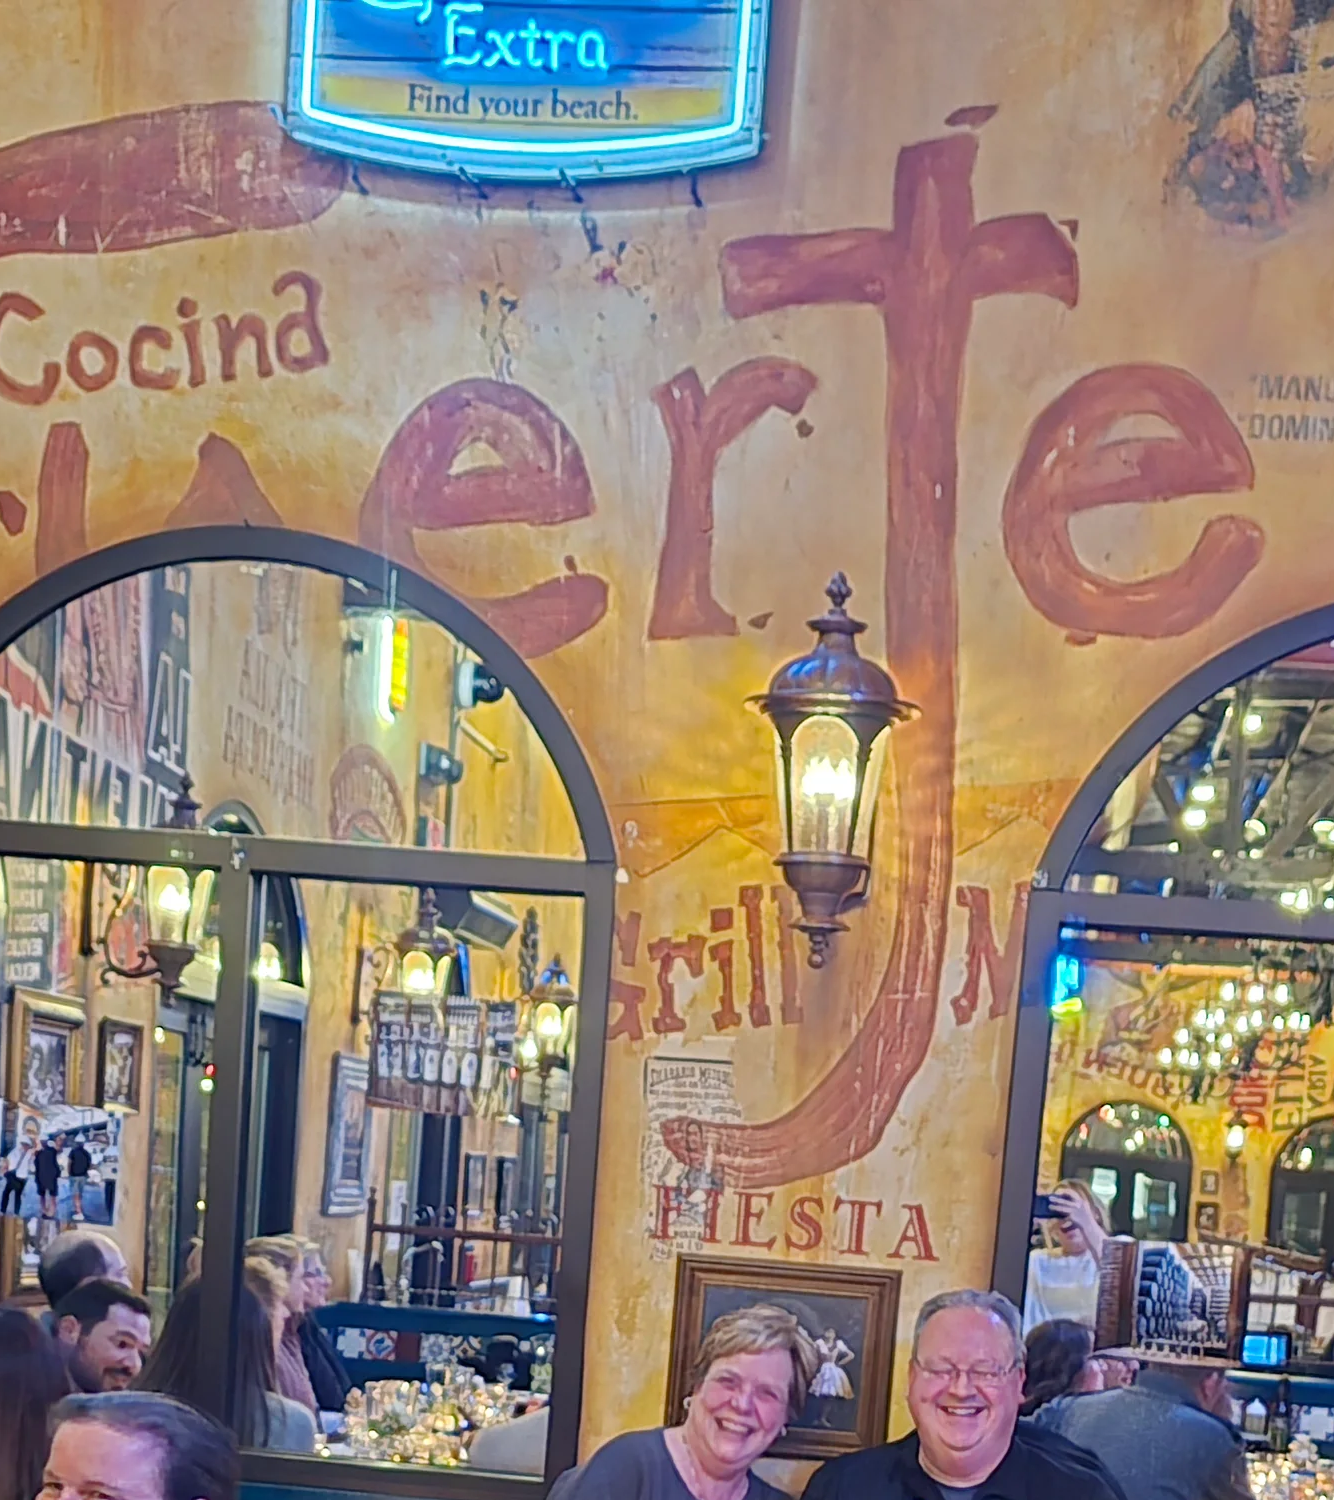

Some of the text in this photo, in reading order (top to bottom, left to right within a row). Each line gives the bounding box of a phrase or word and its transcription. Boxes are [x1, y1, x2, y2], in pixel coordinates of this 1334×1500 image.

[443, 3, 609, 74] Extra
[405, 83, 639, 121] Find your beach.
[649, 1184, 940, 1261] FIESTA
